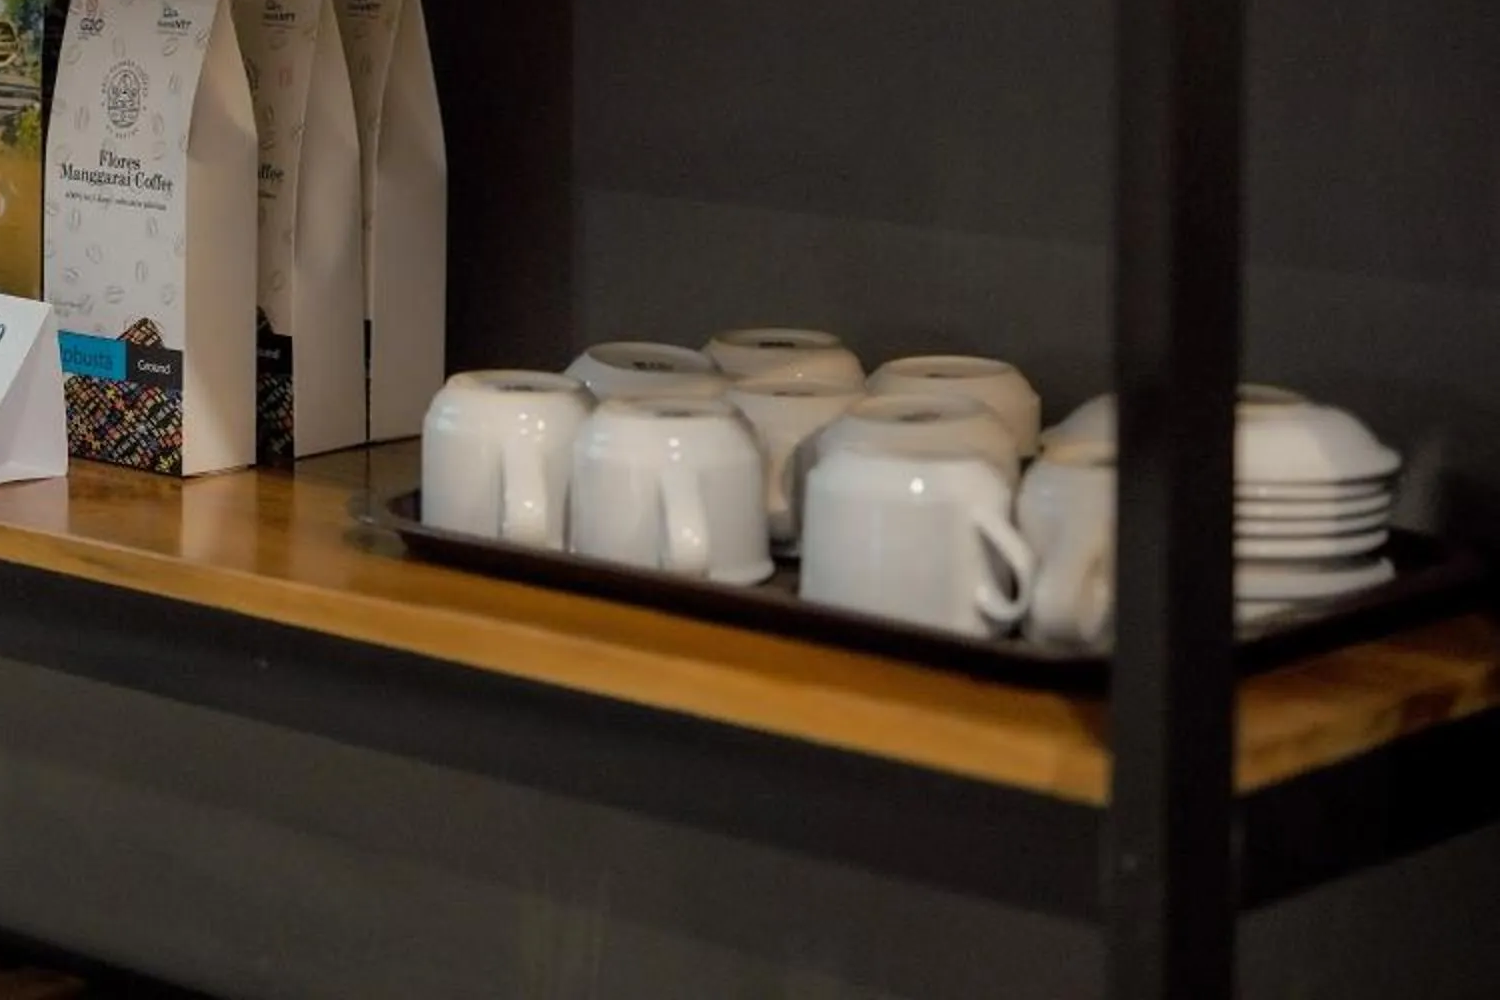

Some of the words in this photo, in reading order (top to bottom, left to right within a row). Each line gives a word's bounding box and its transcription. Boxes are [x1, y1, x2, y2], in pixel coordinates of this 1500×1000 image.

[99, 149, 141, 170] Flores
[60, 162, 131, 187] Manggarai
[135, 171, 173, 192] Coffee
[61, 344, 113, 366] obusta
[137, 359, 171, 375] Ground
